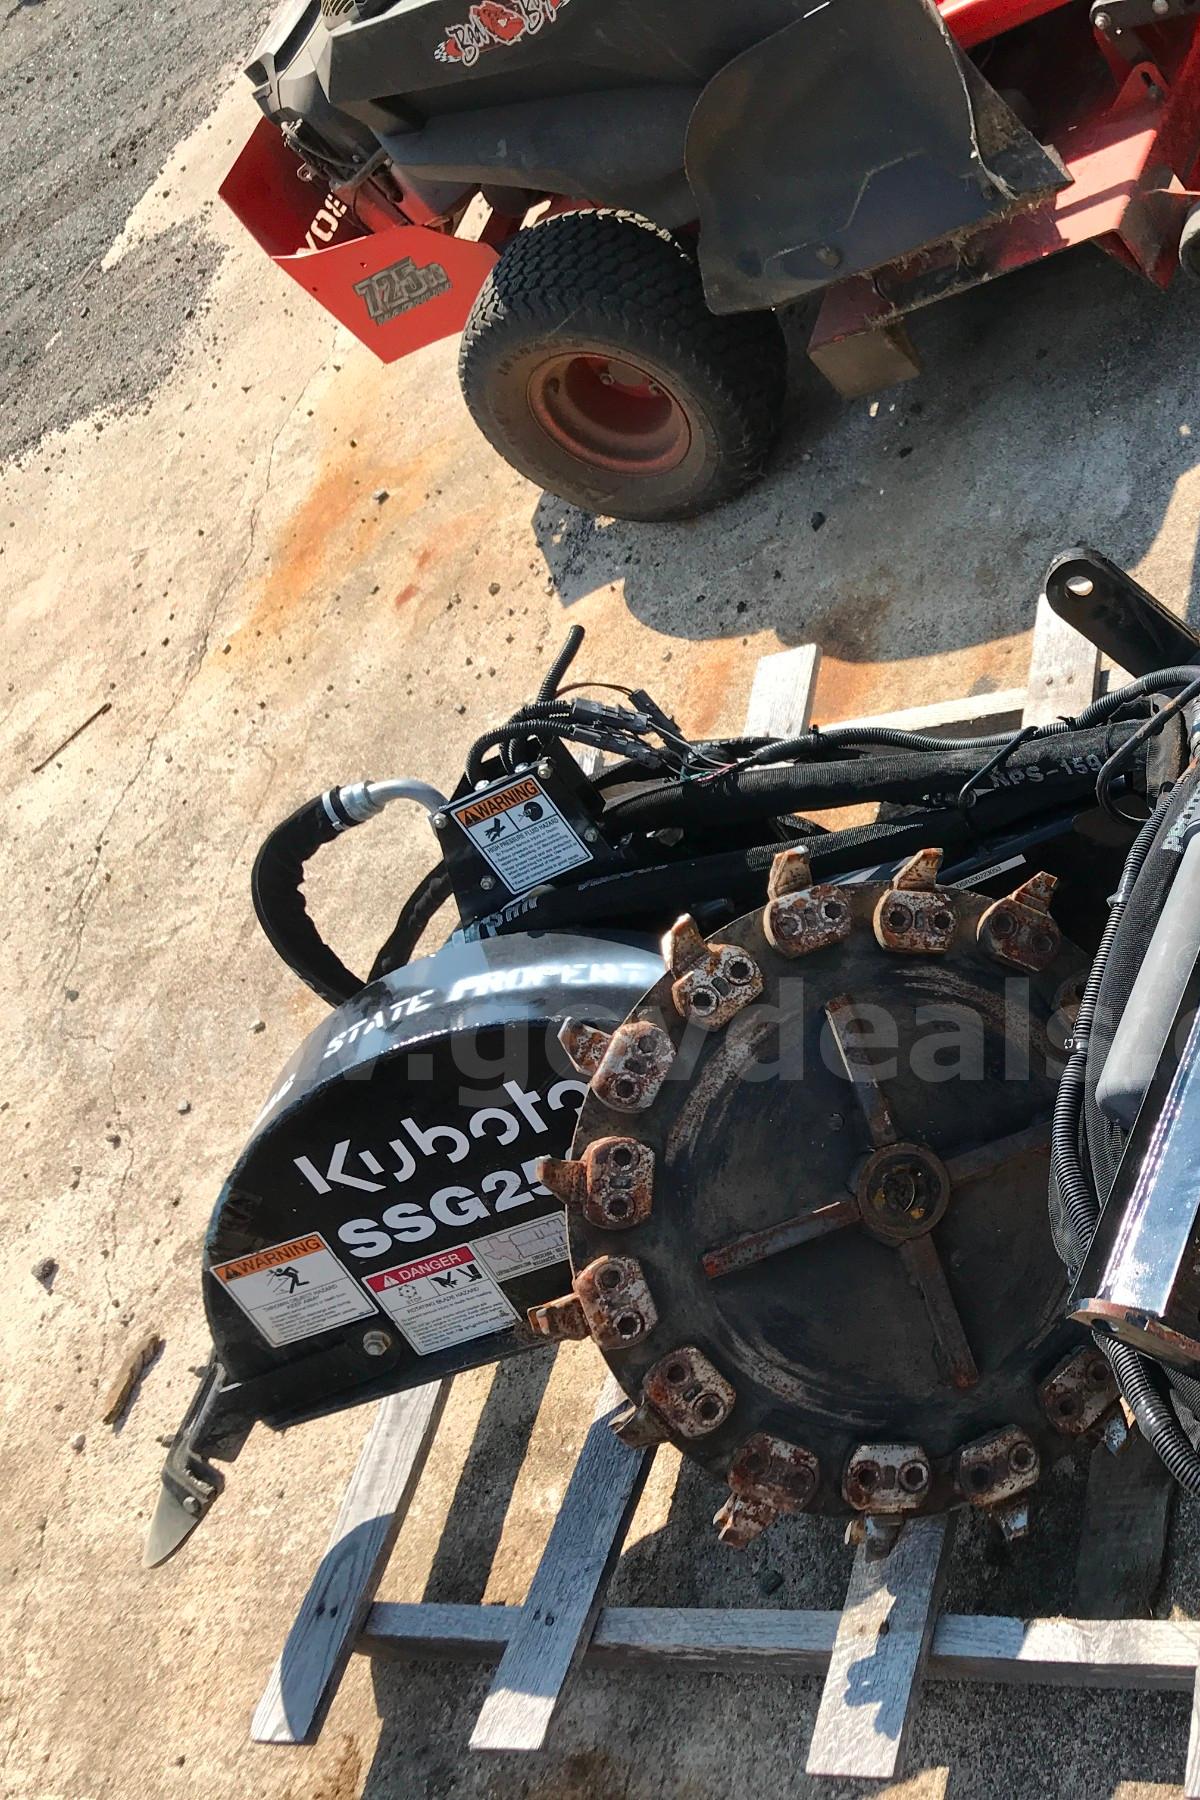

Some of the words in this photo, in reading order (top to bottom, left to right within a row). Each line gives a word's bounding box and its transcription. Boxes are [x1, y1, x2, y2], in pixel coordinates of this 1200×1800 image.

[472, 780, 539, 819] WARNING
[324, 988, 437, 1060] STATE
[447, 961, 664, 1002] PROPERT
[235, 1236, 322, 1275] WARNING
[396, 1252, 462, 1281] DANGER
